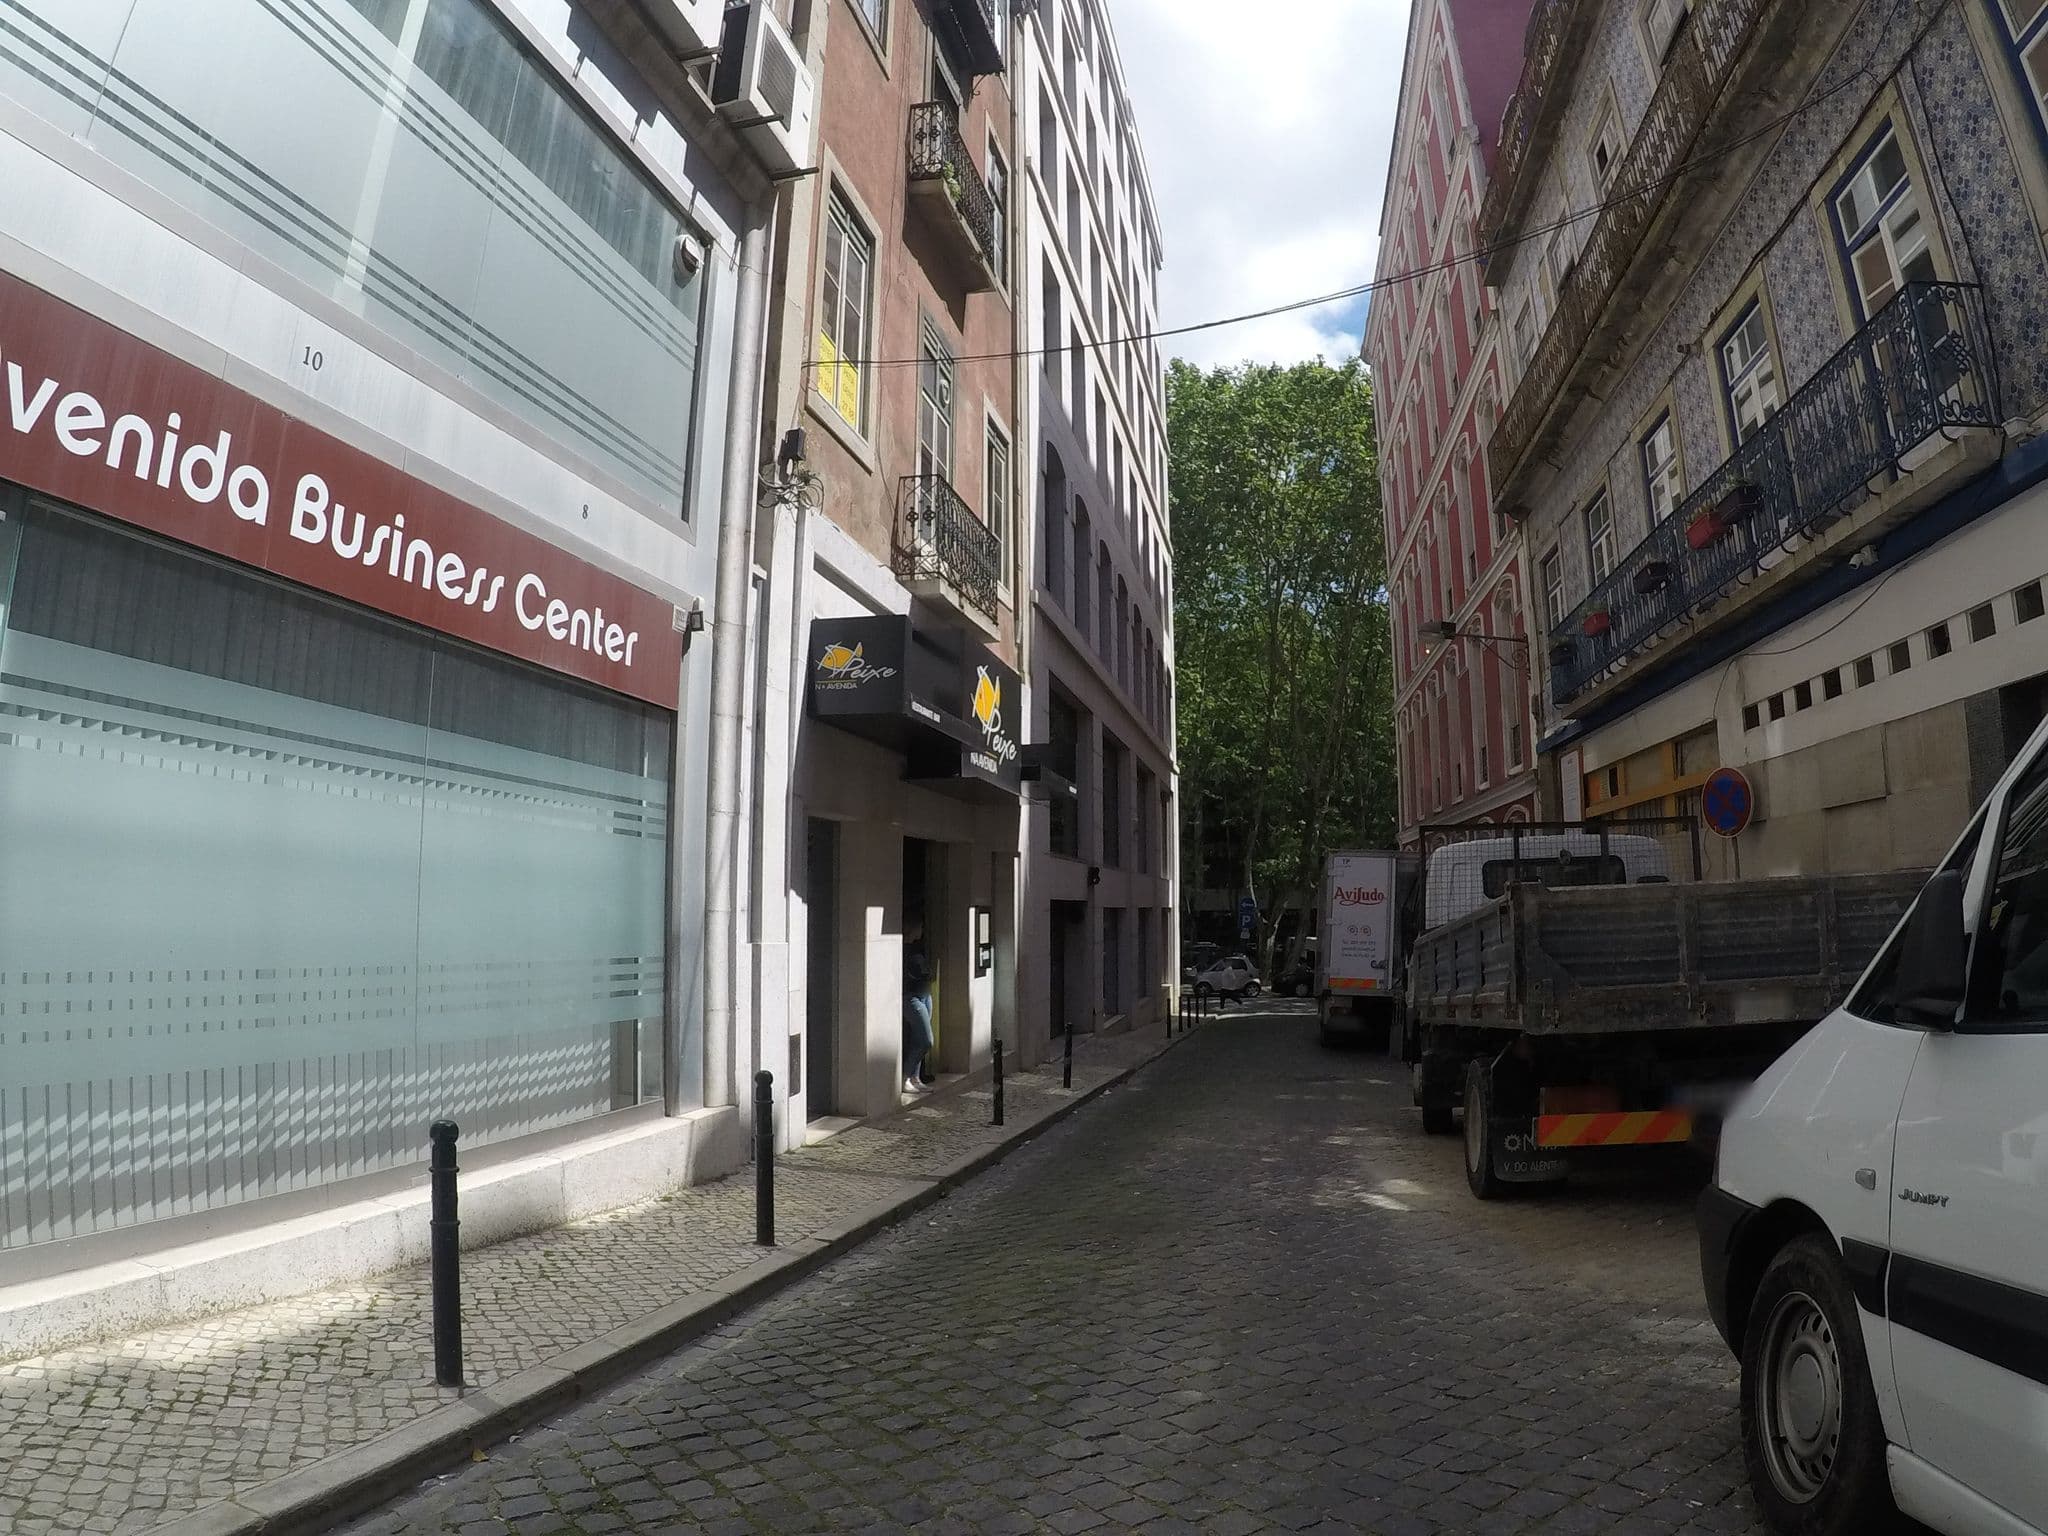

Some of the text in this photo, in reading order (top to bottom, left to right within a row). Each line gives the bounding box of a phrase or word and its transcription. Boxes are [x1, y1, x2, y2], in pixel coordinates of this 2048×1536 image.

[301, 345, 324, 372] 10
[0, 345, 639, 667] venida Business Center
[581, 504, 589, 520] 8
[840, 657, 897, 684] Peixe
[986, 708, 1018, 766] Peixe
[1242, 915, 1251, 926] P
[1898, 1188, 1949, 1207] JUMPY
